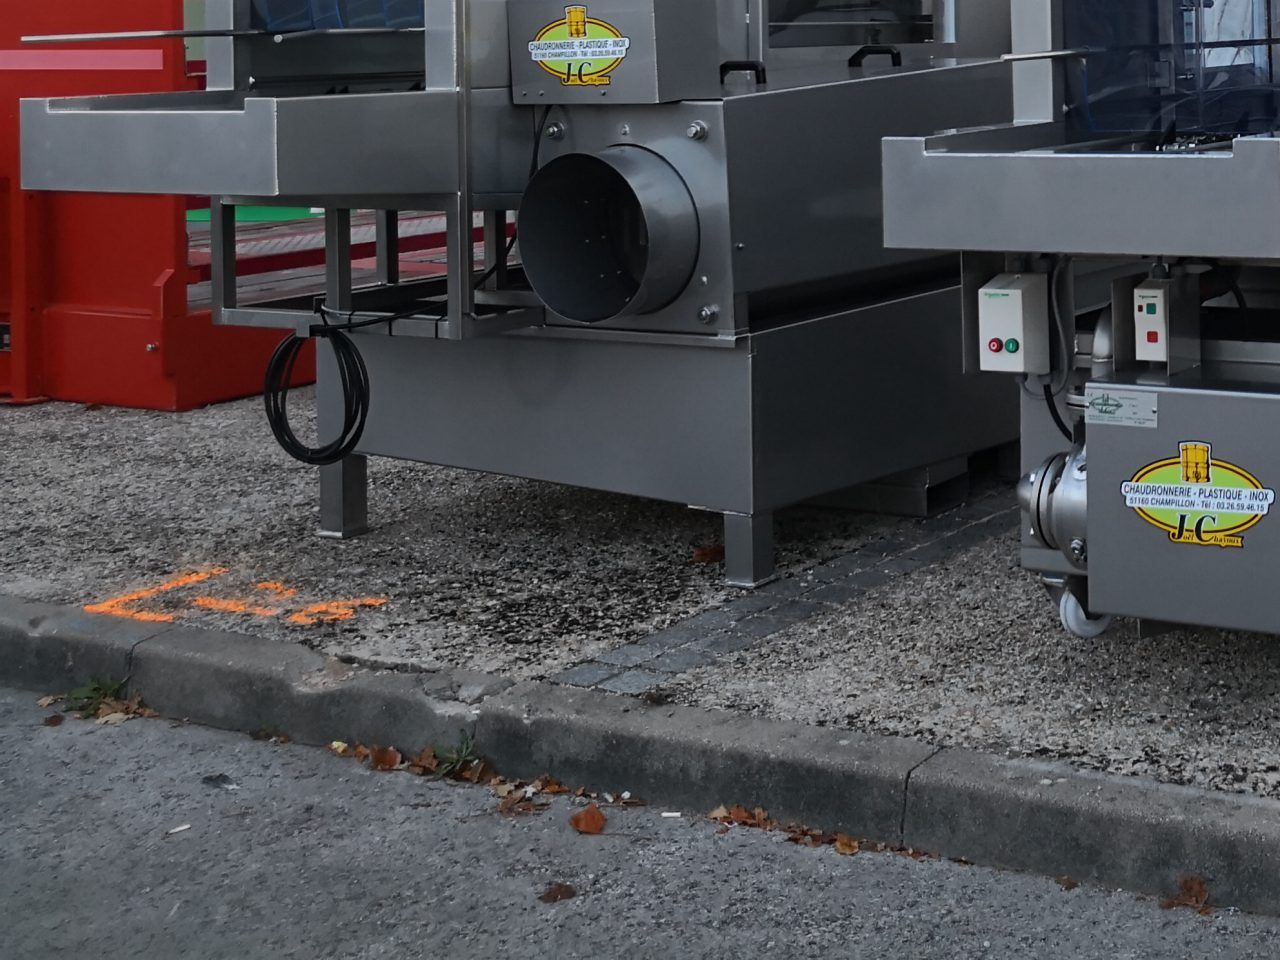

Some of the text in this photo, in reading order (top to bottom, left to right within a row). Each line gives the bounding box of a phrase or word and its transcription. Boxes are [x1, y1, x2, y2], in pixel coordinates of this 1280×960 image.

[579, 40, 609, 49] PLASTIQUE
[1123, 483, 1191, 497] CHAUDRONNERIE
[1198, 489, 1243, 501] PLASTIQUE
[1249, 491, 1269, 501] INOX
[1129, 497, 1149, 506] 51160
[1150, 498, 1195, 508] CHAMPILLON
[1216, 502, 1265, 513] 03.26.59.46.15
